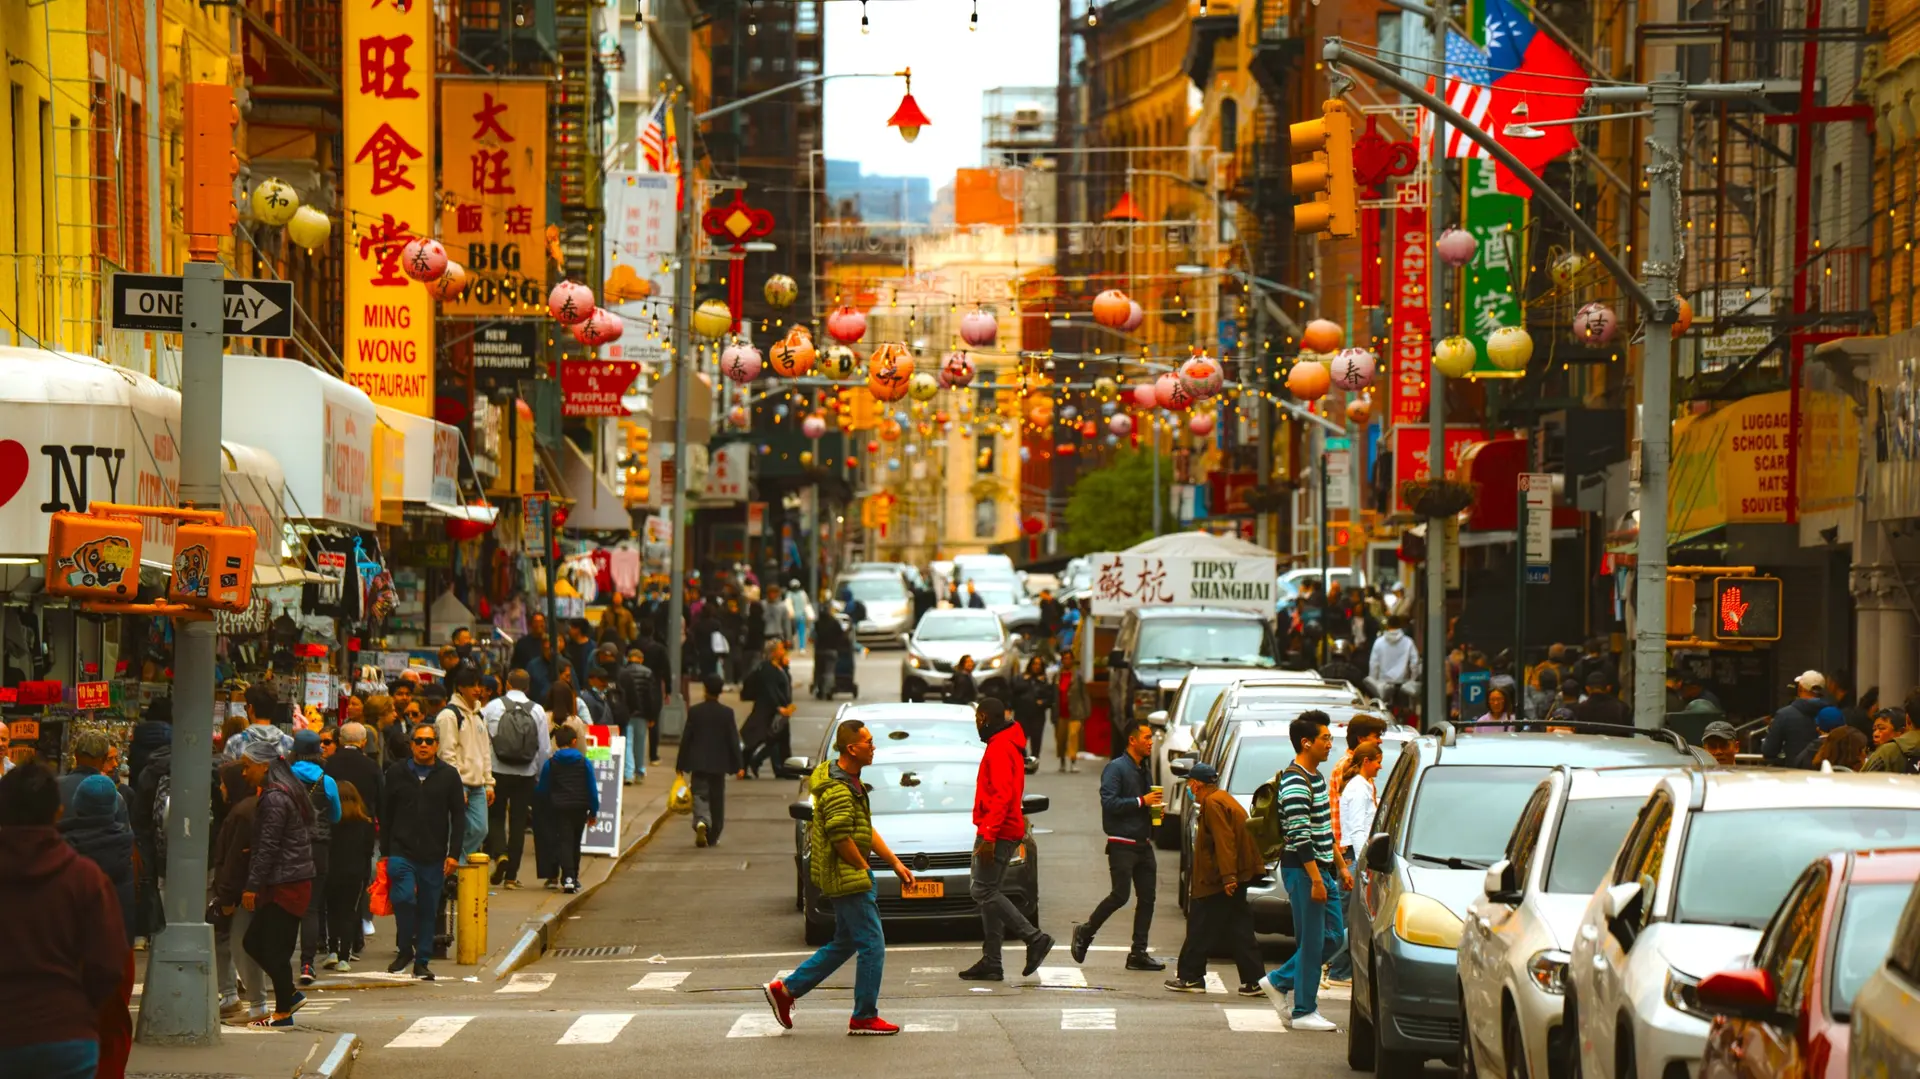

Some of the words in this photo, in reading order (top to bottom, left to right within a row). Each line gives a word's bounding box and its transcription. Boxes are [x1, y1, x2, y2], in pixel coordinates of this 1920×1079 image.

[354, 0, 423, 287] 旺食堂
[470, 93, 515, 196] 大旺
[265, 188, 289, 209] 和
[468, 243, 520, 270] BIG
[1402, 231, 1424, 308] CANTON
[364, 305, 411, 329] MING
[560, 296, 578, 321] 春
[485, 330, 507, 341] NEW
[358, 339, 417, 363] WONG
[1343, 358, 1364, 386] 春
[349, 371, 427, 399] RESTAURANT
[565, 404, 623, 416] PHARMACY
[1732, 434, 1778, 452] SCHOOL
[40, 445, 125, 514] NY
[1096, 556, 1174, 603] 蘇杭
[1191, 561, 1237, 579] TIPSY
[1190, 581, 1270, 601] SHANGHAI
